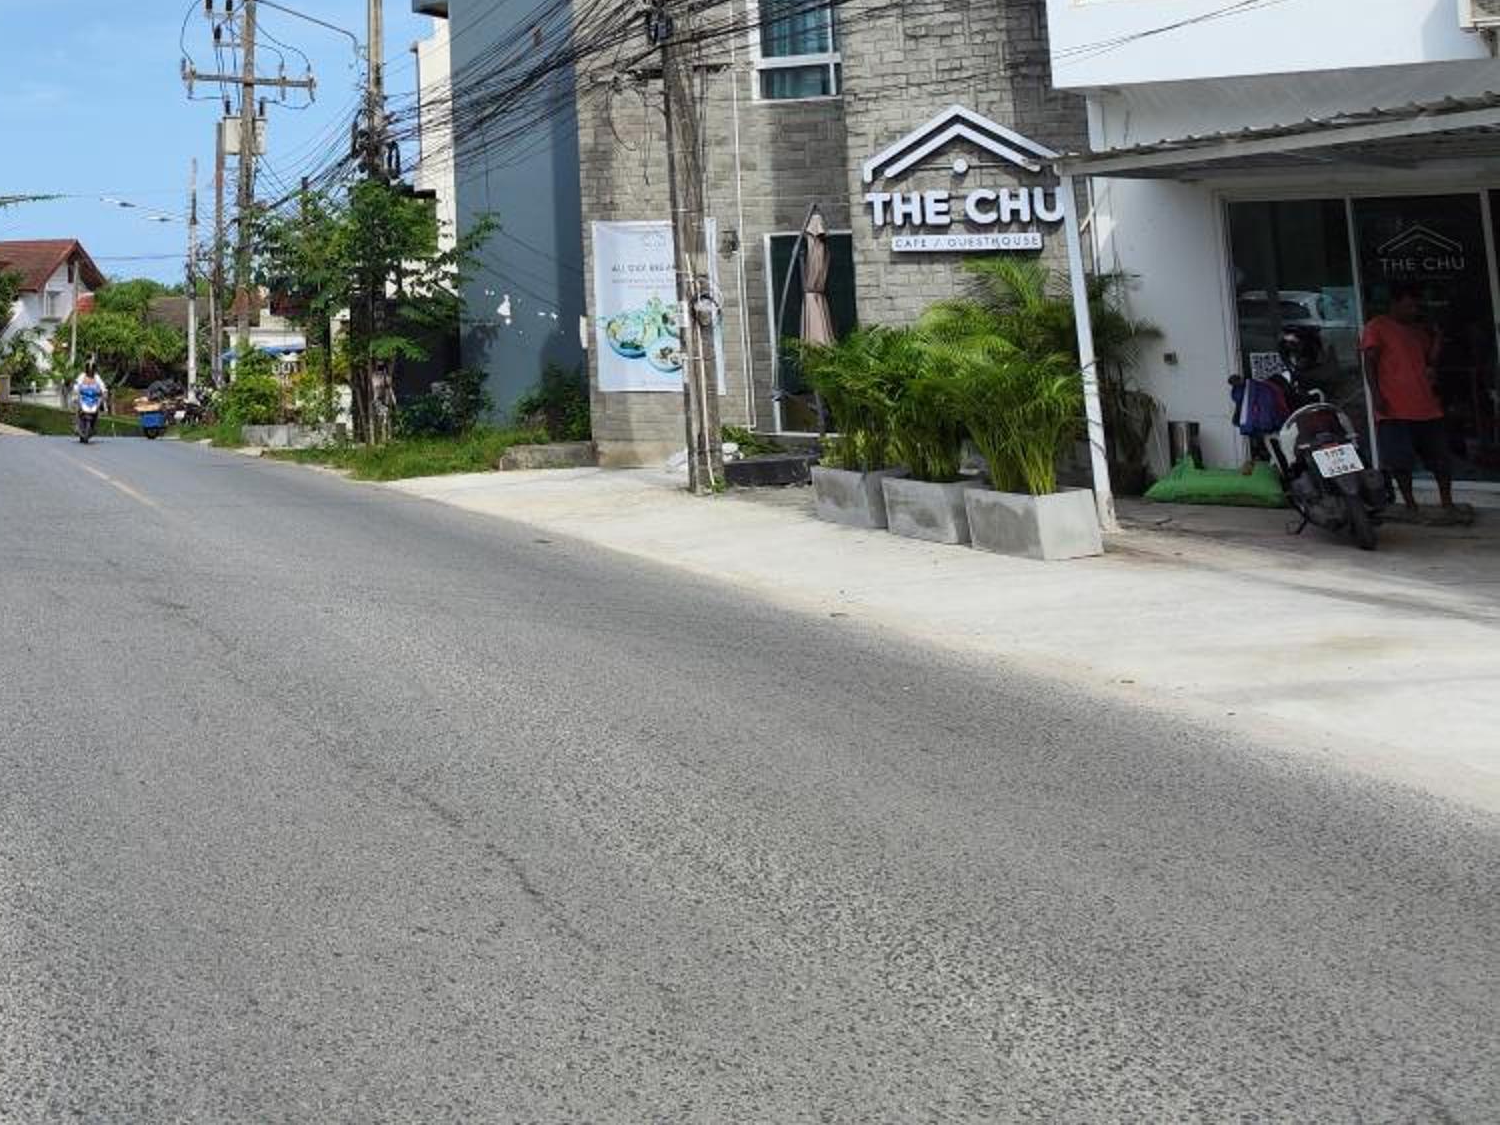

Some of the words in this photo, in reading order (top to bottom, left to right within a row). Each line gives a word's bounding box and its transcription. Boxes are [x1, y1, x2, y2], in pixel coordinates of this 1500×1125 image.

[865, 190, 950, 225] THE
[965, 187, 1065, 224] CHU
[947, 236, 1039, 248] GUESTHOUSE
[1380, 258, 1416, 272] THE
[1423, 256, 1465, 270] CHU
